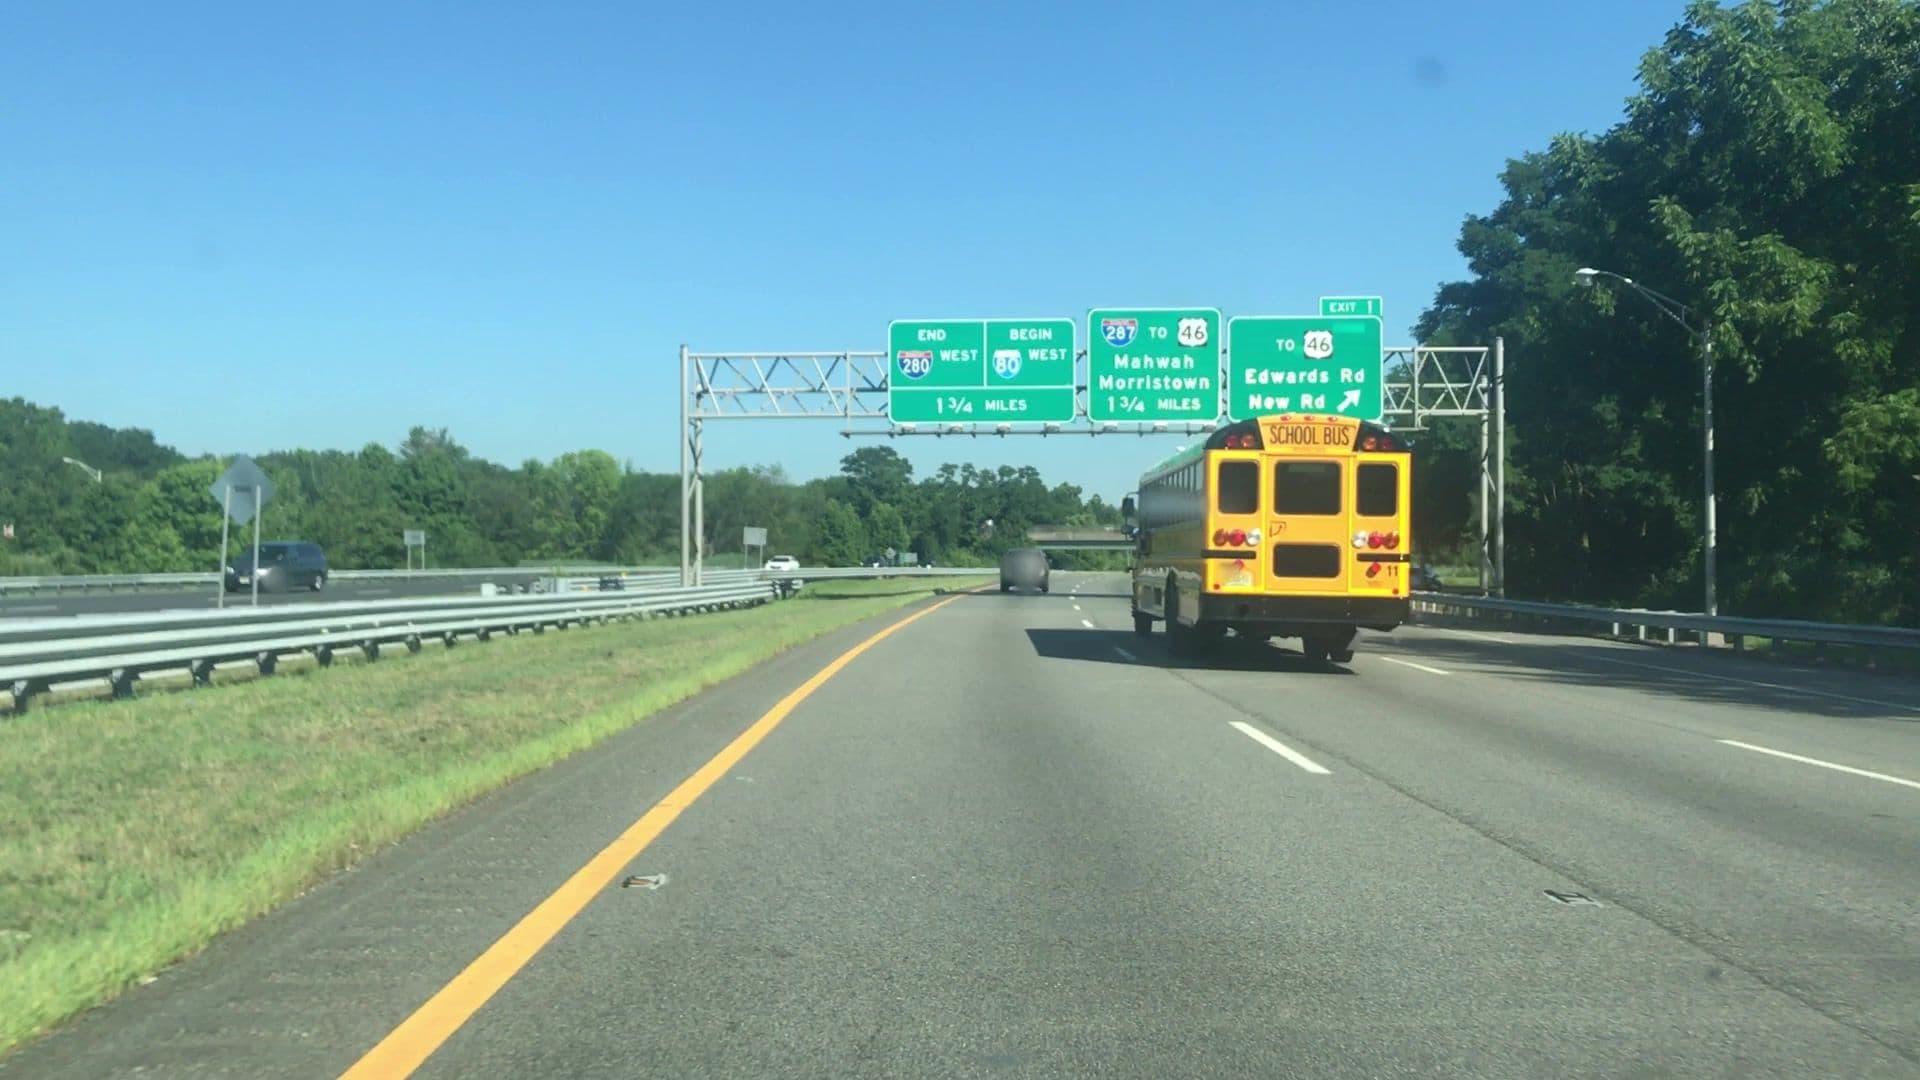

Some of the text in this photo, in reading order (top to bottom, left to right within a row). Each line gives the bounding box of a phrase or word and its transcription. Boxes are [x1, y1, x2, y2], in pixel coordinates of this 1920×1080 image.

[1329, 300, 1373, 314] EXIT 1
[917, 329, 947, 341] END
[1009, 328, 1053, 341] BEGIN
[1106, 325, 1205, 341] 287 TO 46
[1276, 337, 1330, 352] TO 46
[903, 349, 978, 374] 280 WEST
[995, 348, 1067, 374] 80 WEST
[1113, 353, 1194, 369] Mahwah
[1099, 374, 1210, 390] Morristown
[1244, 367, 1365, 385] Edwards Rd
[936, 397, 944, 414] 1
[984, 399, 1028, 412] MILES
[1108, 395, 1115, 413] 1
[1157, 398, 1201, 411] MILES
[1248, 393, 1325, 410] New Rd
[1269, 425, 1350, 446] SCHOOL BUS
[1387, 565, 1398, 577] 11
